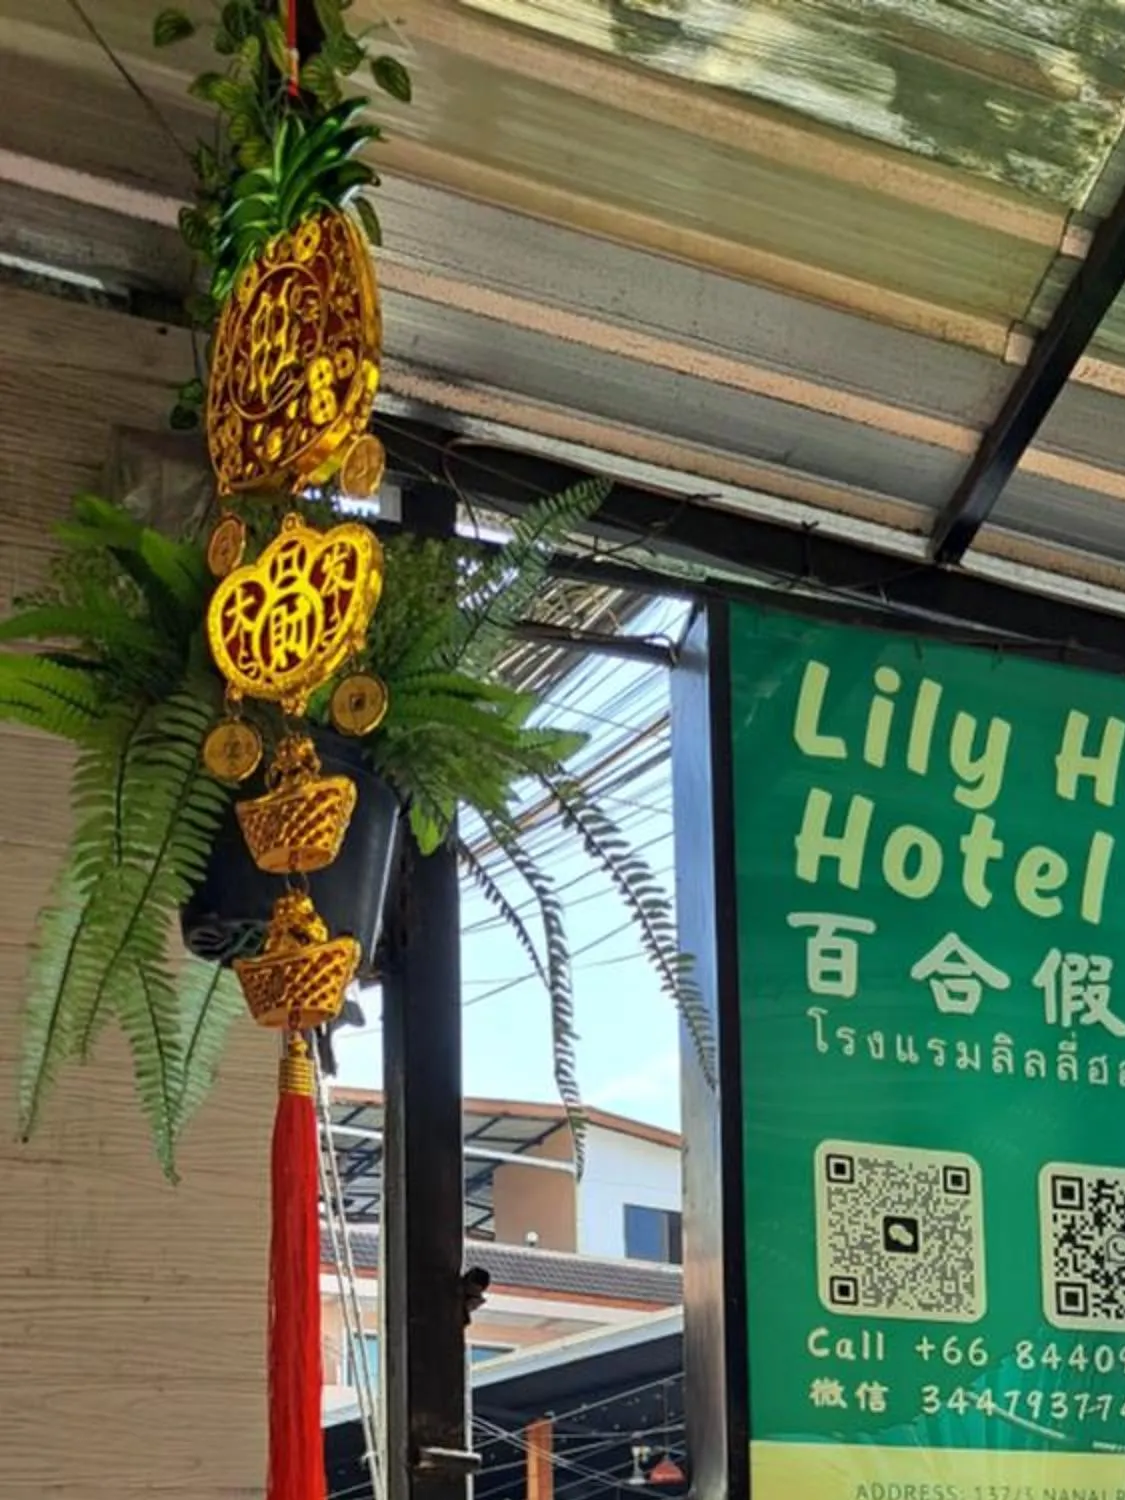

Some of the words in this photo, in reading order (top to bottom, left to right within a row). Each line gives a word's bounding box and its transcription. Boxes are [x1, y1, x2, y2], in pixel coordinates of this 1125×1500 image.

[793, 660, 1011, 811] Lily
[794, 788, 1115, 924] Hotel
[807, 1328, 885, 1361] Call
[915, 1336, 989, 1367] +66
[809, 1378, 889, 1414] 微信
